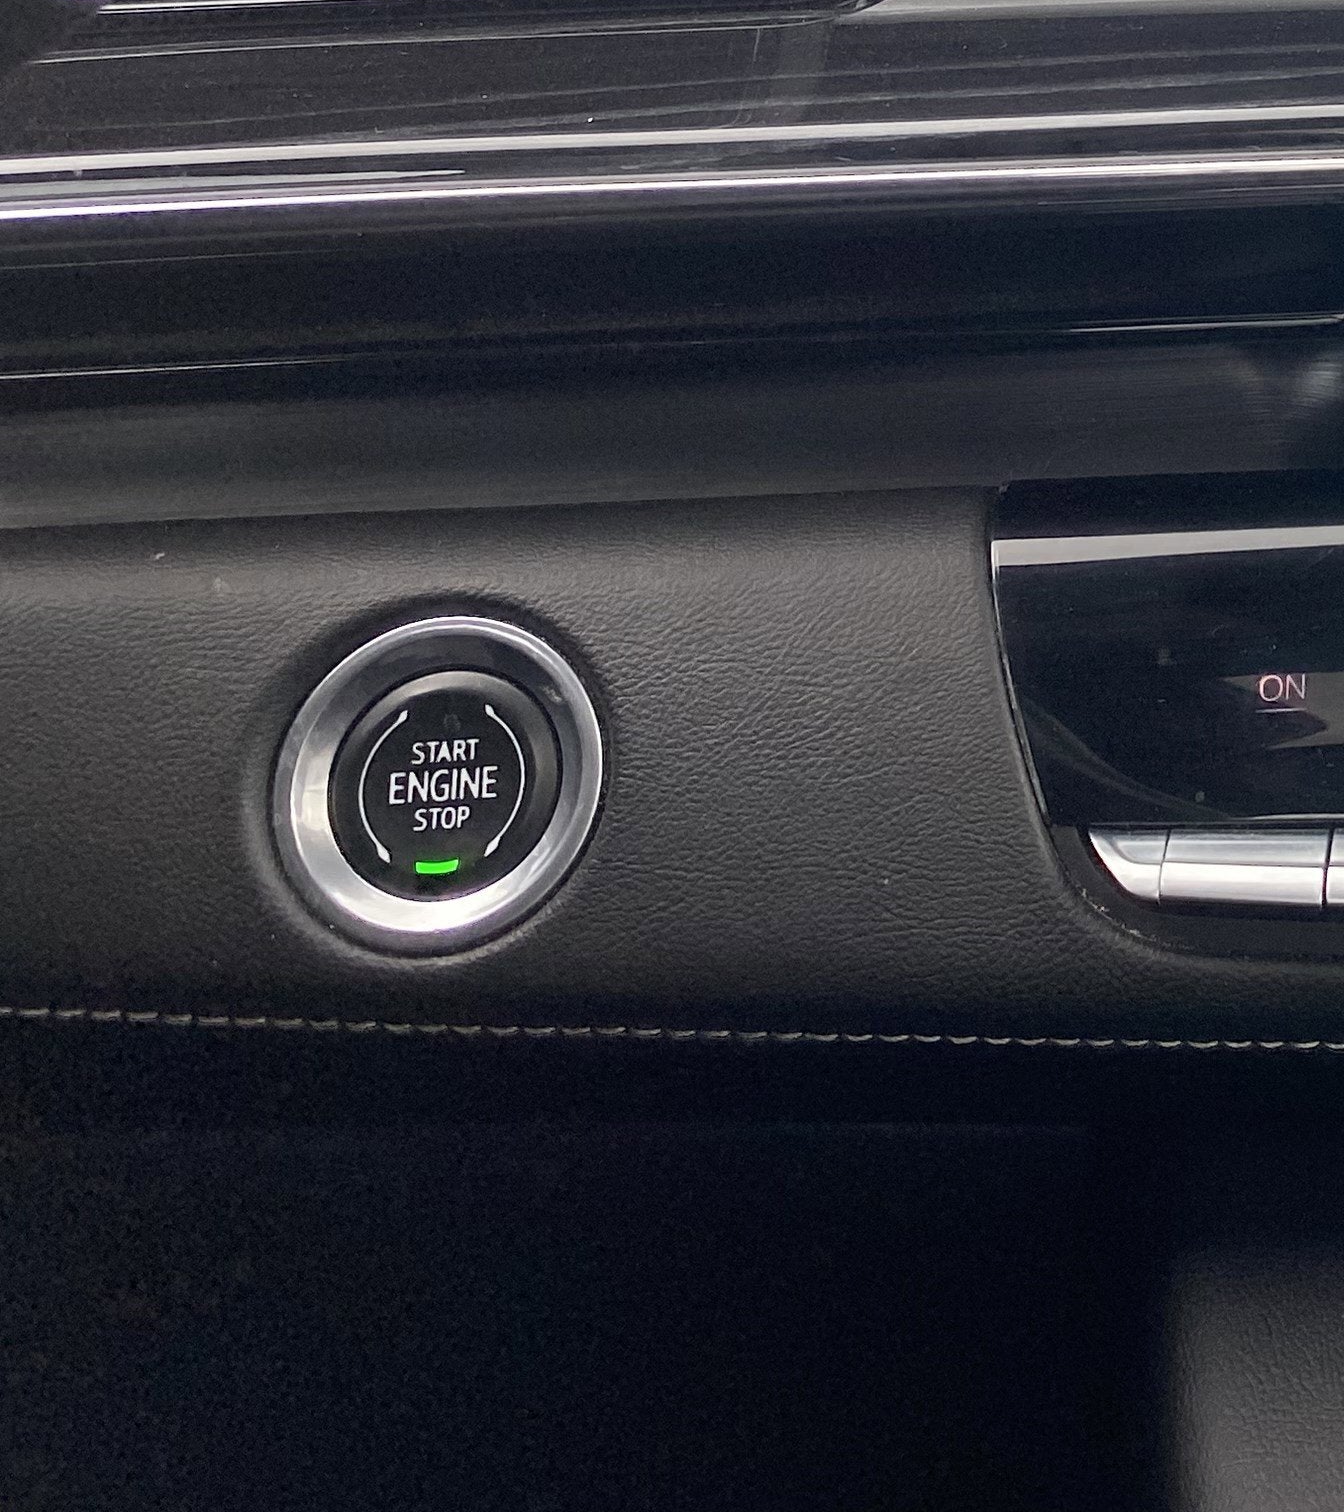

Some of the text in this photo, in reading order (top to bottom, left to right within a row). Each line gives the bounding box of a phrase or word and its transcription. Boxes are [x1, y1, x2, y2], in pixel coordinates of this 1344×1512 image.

[1258, 674, 1306, 702] ON
[411, 738, 480, 766] START
[388, 765, 499, 805] ENGINE
[413, 805, 471, 832] STOP
